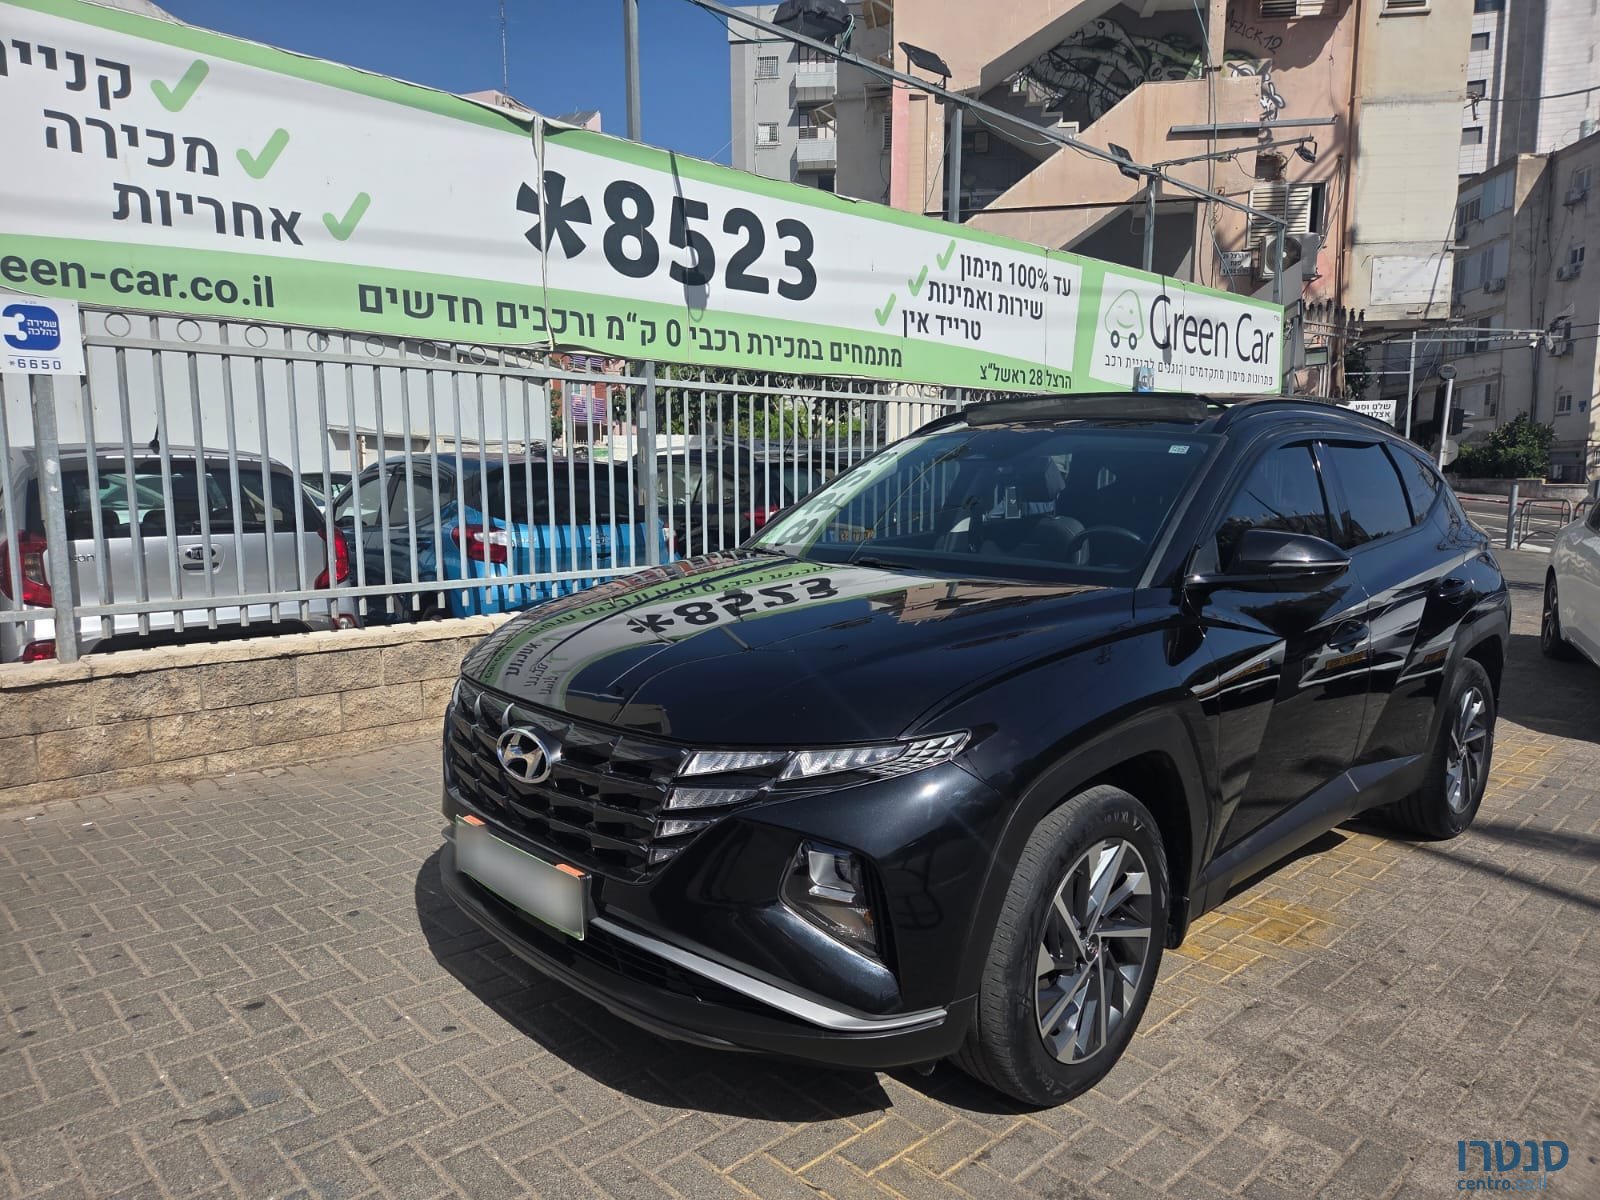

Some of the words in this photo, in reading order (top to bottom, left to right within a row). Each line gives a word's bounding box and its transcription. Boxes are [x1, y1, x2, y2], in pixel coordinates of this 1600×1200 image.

[43, 108, 220, 177] מכירה
[112, 182, 304, 246] אחריות
[1, 254, 275, 308] een-car.co.il
[960, 253, 1003, 283] מימון
[1008, 262, 1049, 293] 100%
[928, 280, 993, 312] ואמינות
[1053, 275, 1071, 297] עד
[358, 283, 483, 326] חדשים
[495, 298, 594, 338] ורכבים
[997, 292, 1043, 320] שירות
[27, 319, 57, 328] שמירה
[27, 327, 58, 337] כהלכה
[666, 319, 682, 345] 0
[902, 308, 929, 341] אין
[935, 313, 981, 341] טרייד
[1149, 294, 1228, 358] Green
[1235, 312, 1274, 365] Car
[689, 324, 741, 354] רכבי
[746, 333, 823, 362] במכירת
[829, 343, 903, 368] מתמחים
[1104, 354, 1122, 368] רכב
[1029, 368, 1043, 386] 28
[1046, 370, 1072, 389] הרצל
[1190, 365, 1224, 381] מתקדמים
